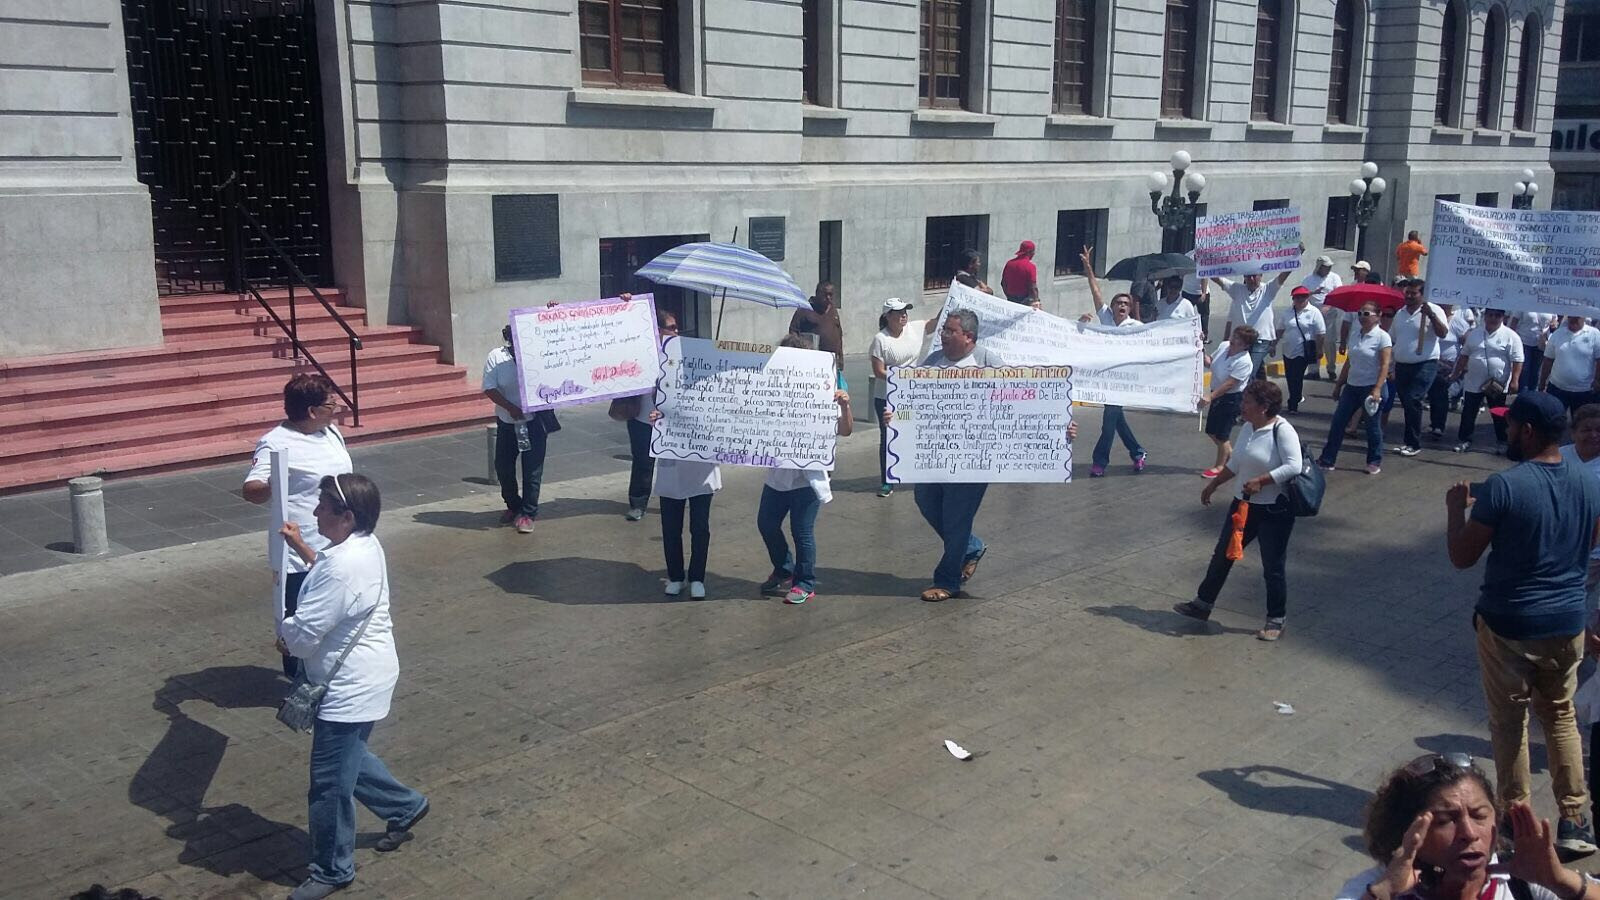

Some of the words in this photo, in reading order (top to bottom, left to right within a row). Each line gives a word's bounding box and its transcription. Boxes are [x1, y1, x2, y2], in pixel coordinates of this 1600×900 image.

[1441, 204, 1460, 213] BASE
[1467, 208, 1516, 220] TRABAJADORA
[1520, 214, 1535, 222] DEL
[758, 344, 772, 353] 28
[716, 359, 728, 372] del
[899, 370, 910, 379] LA
[914, 370, 933, 379] BASE
[935, 369, 983, 379] TRABAJADORA
[994, 369, 1026, 378] ISSSTE
[1032, 369, 1067, 378] TAMPICO
[742, 386, 749, 395] de
[910, 380, 960, 391] Desaprobamos
[964, 380, 969, 389] la
[1010, 380, 1038, 388] nuestro
[1040, 381, 1065, 391] cuerpo
[698, 392, 705, 402] de
[898, 390, 905, 400] de
[990, 390, 1020, 400] Articulo
[1021, 389, 1036, 400] 28
[1039, 390, 1049, 400] De
[1052, 389, 1066, 400] las
[937, 401, 975, 412] Generales
[979, 400, 986, 410] de
[777, 408, 784, 418] de
[897, 411, 910, 420] VIII
[990, 410, 1014, 420] titular
[688, 439, 708, 452] turno
[819, 440, 828, 450] de
[1006, 443, 1011, 452] y
[1024, 439, 1054, 452] general
[948, 453, 962, 464] que
[965, 450, 992, 460] resulte
[997, 450, 1034, 460] necesario
[1050, 450, 1060, 460] la
[950, 463, 956, 474] y
[996, 462, 1009, 473] que
